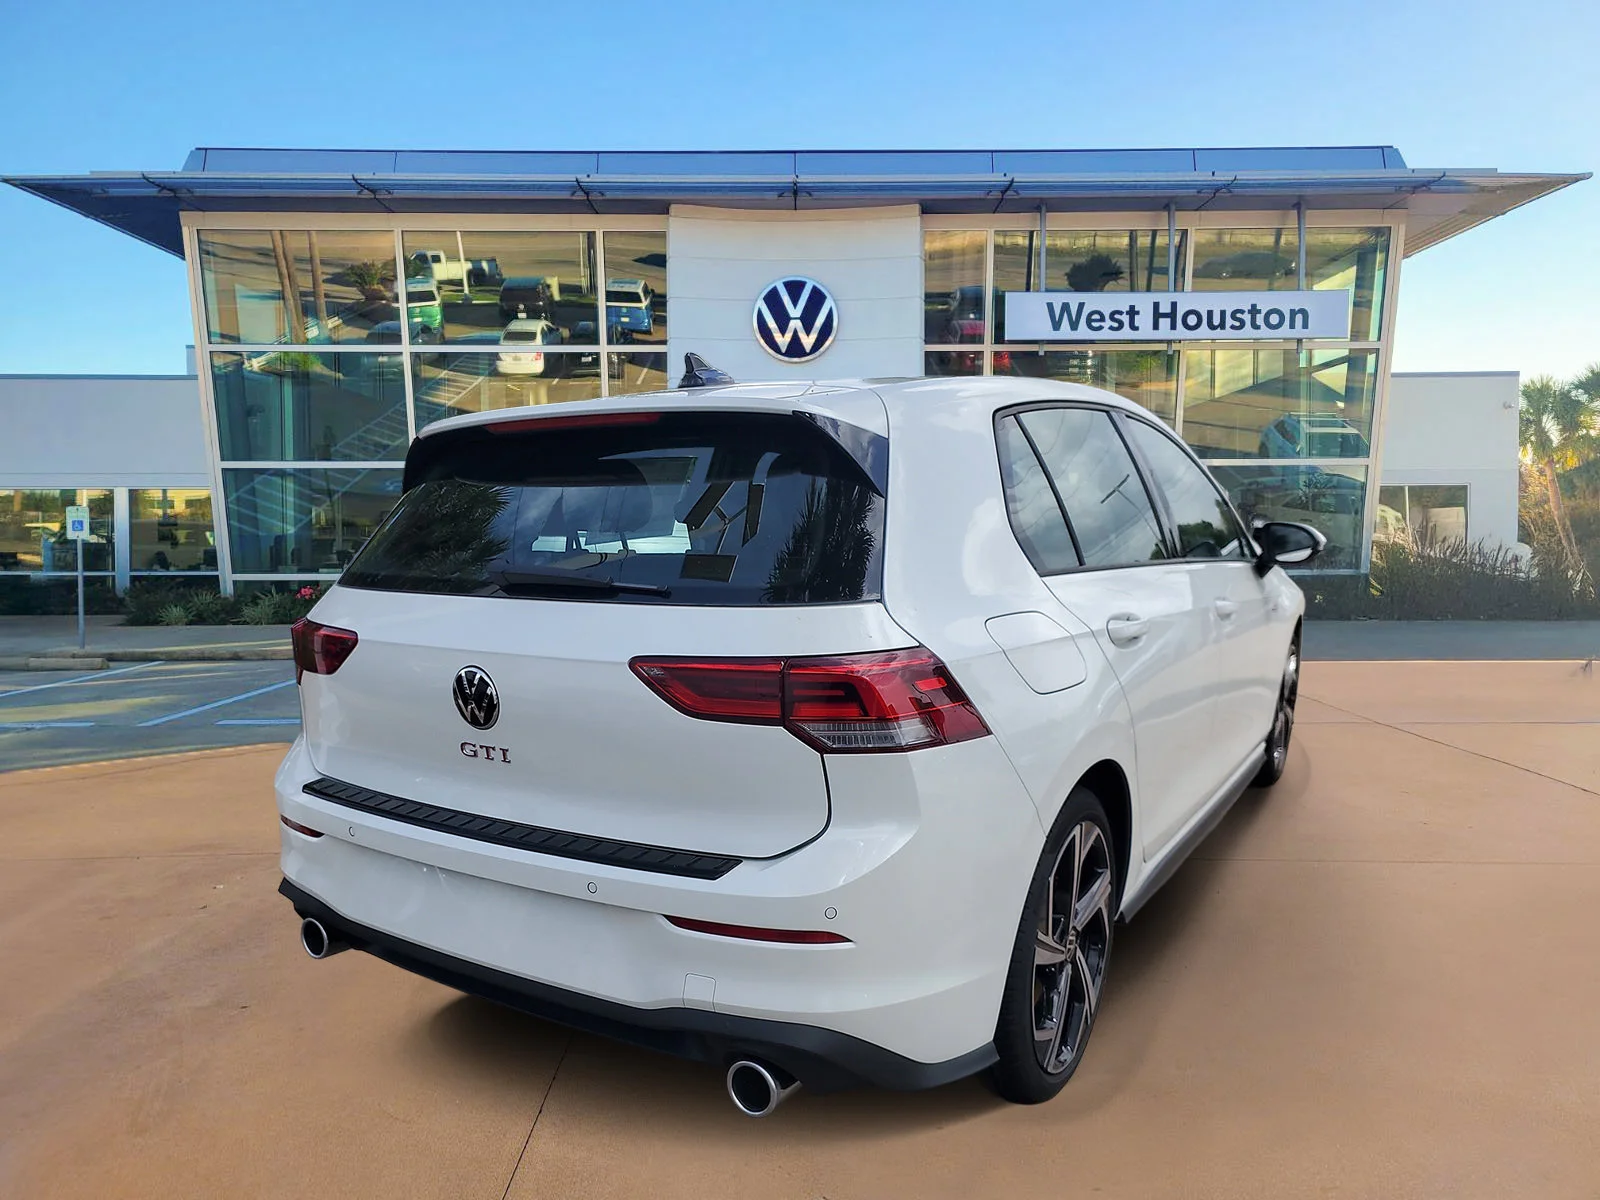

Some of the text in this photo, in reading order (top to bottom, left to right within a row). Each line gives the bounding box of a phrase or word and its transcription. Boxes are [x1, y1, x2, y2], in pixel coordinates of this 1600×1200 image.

[755, 277, 836, 360] VW
[1046, 301, 1310, 332] West Houston
[460, 741, 511, 763] GTI
